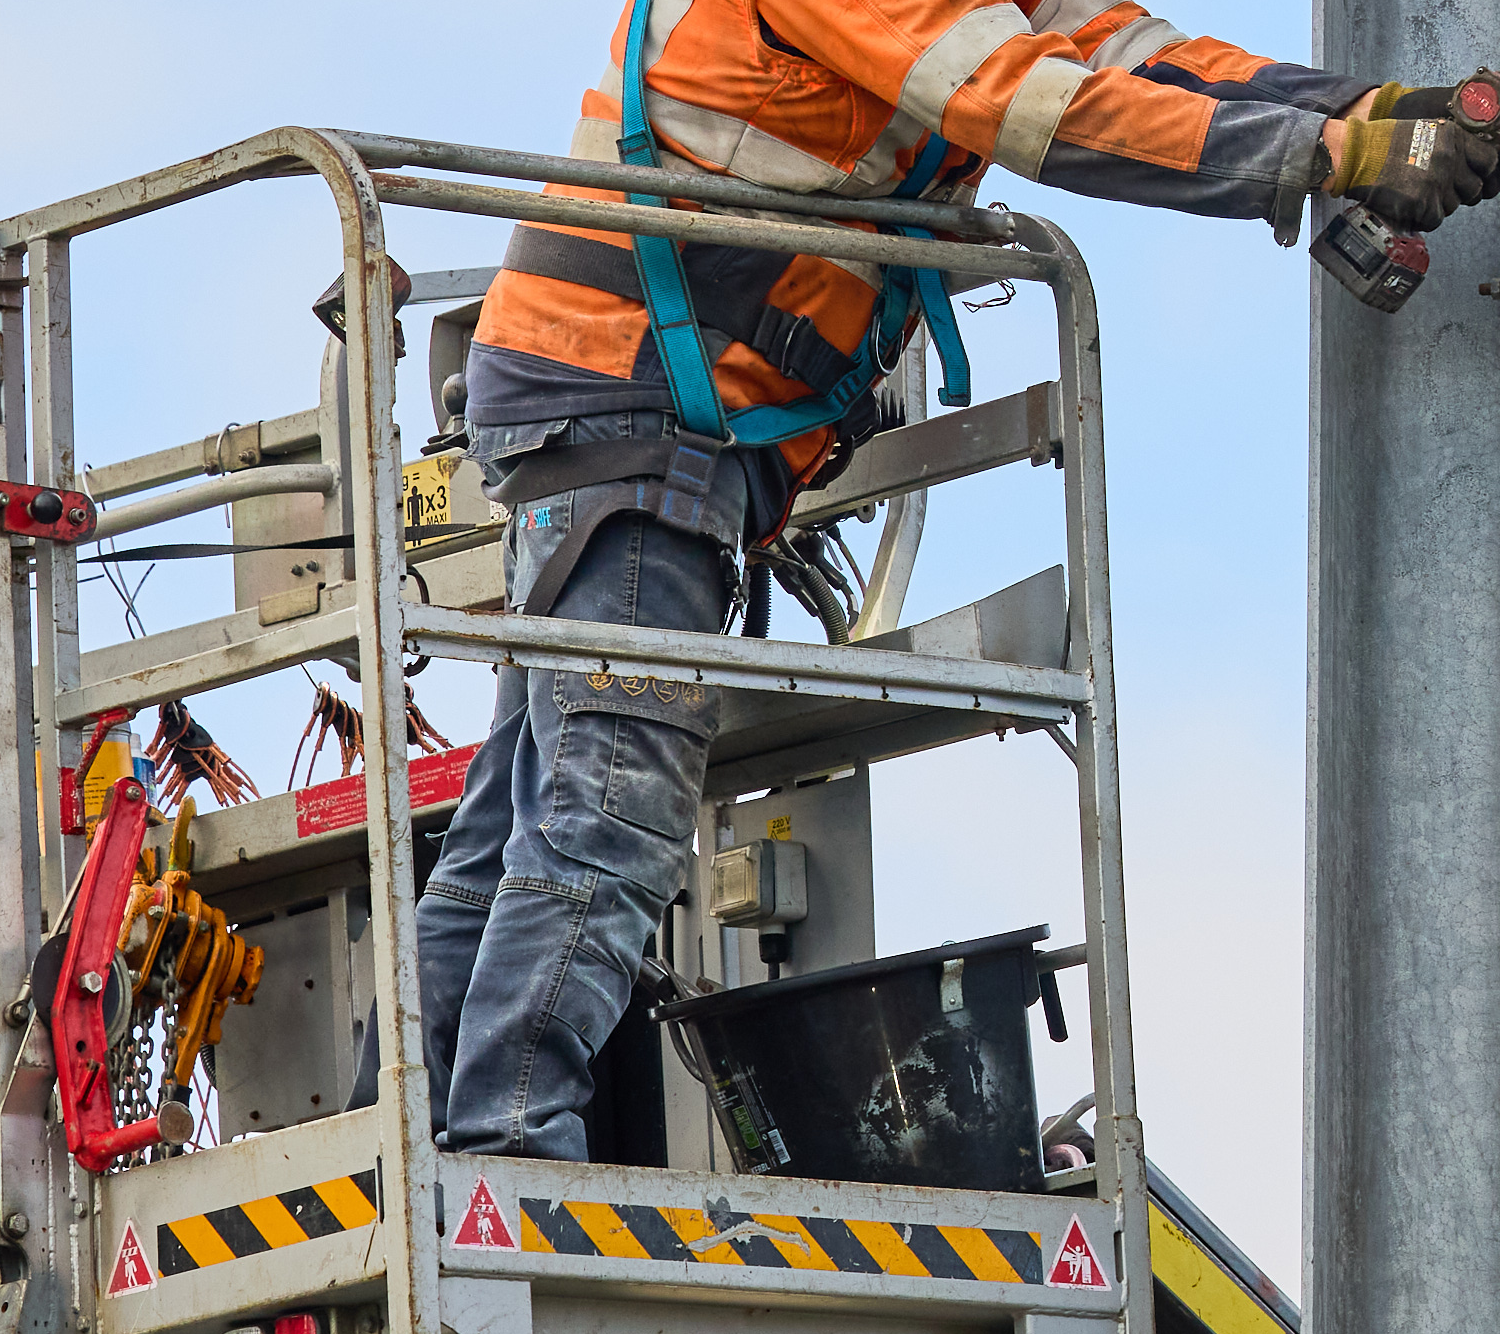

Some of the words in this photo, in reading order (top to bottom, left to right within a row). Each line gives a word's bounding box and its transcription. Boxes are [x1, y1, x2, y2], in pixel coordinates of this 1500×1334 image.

[425, 485, 447, 514] x3
[426, 512, 447, 525] MAXI
[772, 818, 785, 829] 220
